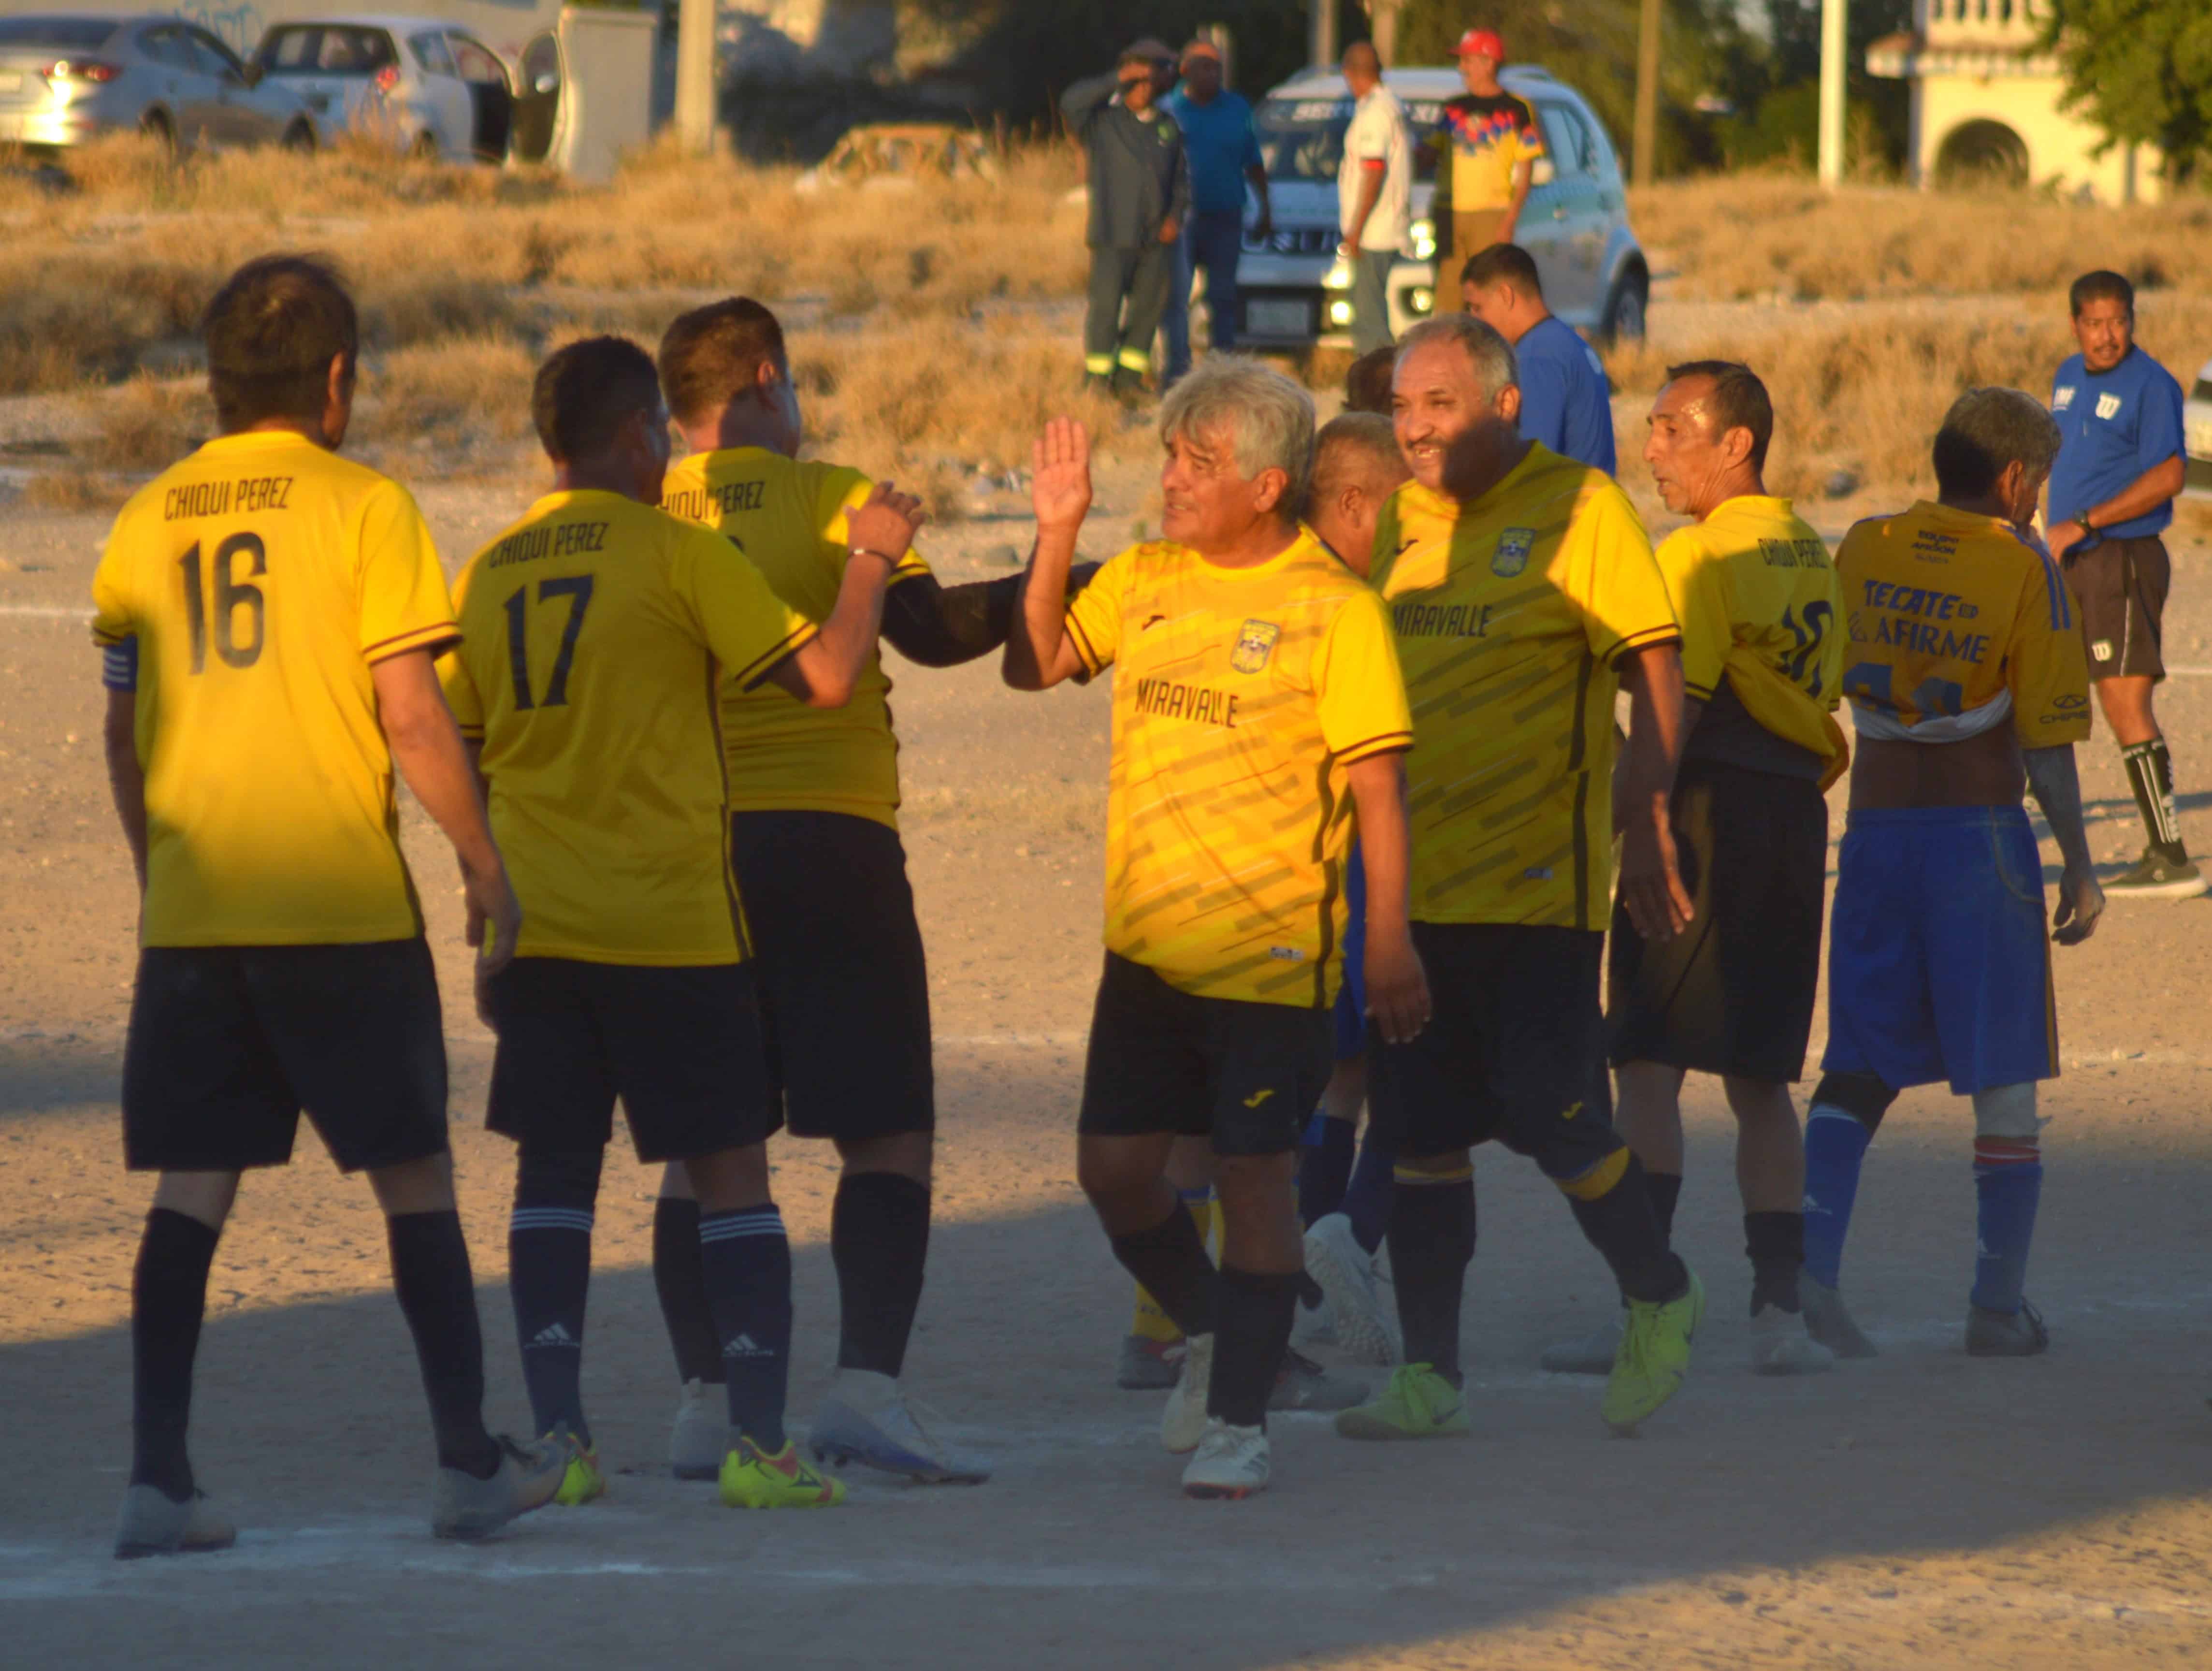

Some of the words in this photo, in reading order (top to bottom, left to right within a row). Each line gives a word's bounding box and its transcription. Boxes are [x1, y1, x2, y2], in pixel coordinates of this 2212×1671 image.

[164, 480, 231, 522] CHIQUI
[234, 477, 293, 512] PEREZ
[489, 527, 550, 568] CHIQUI
[553, 522, 610, 557] PEREZ
[177, 531, 267, 676] 16
[1393, 603, 1493, 638] MIRAVALLE
[1864, 579, 1962, 620] TECATE
[504, 573, 594, 711] 17
[1873, 616, 1991, 664] AFIRME
[1135, 678, 1239, 728] MIRAVALLE
